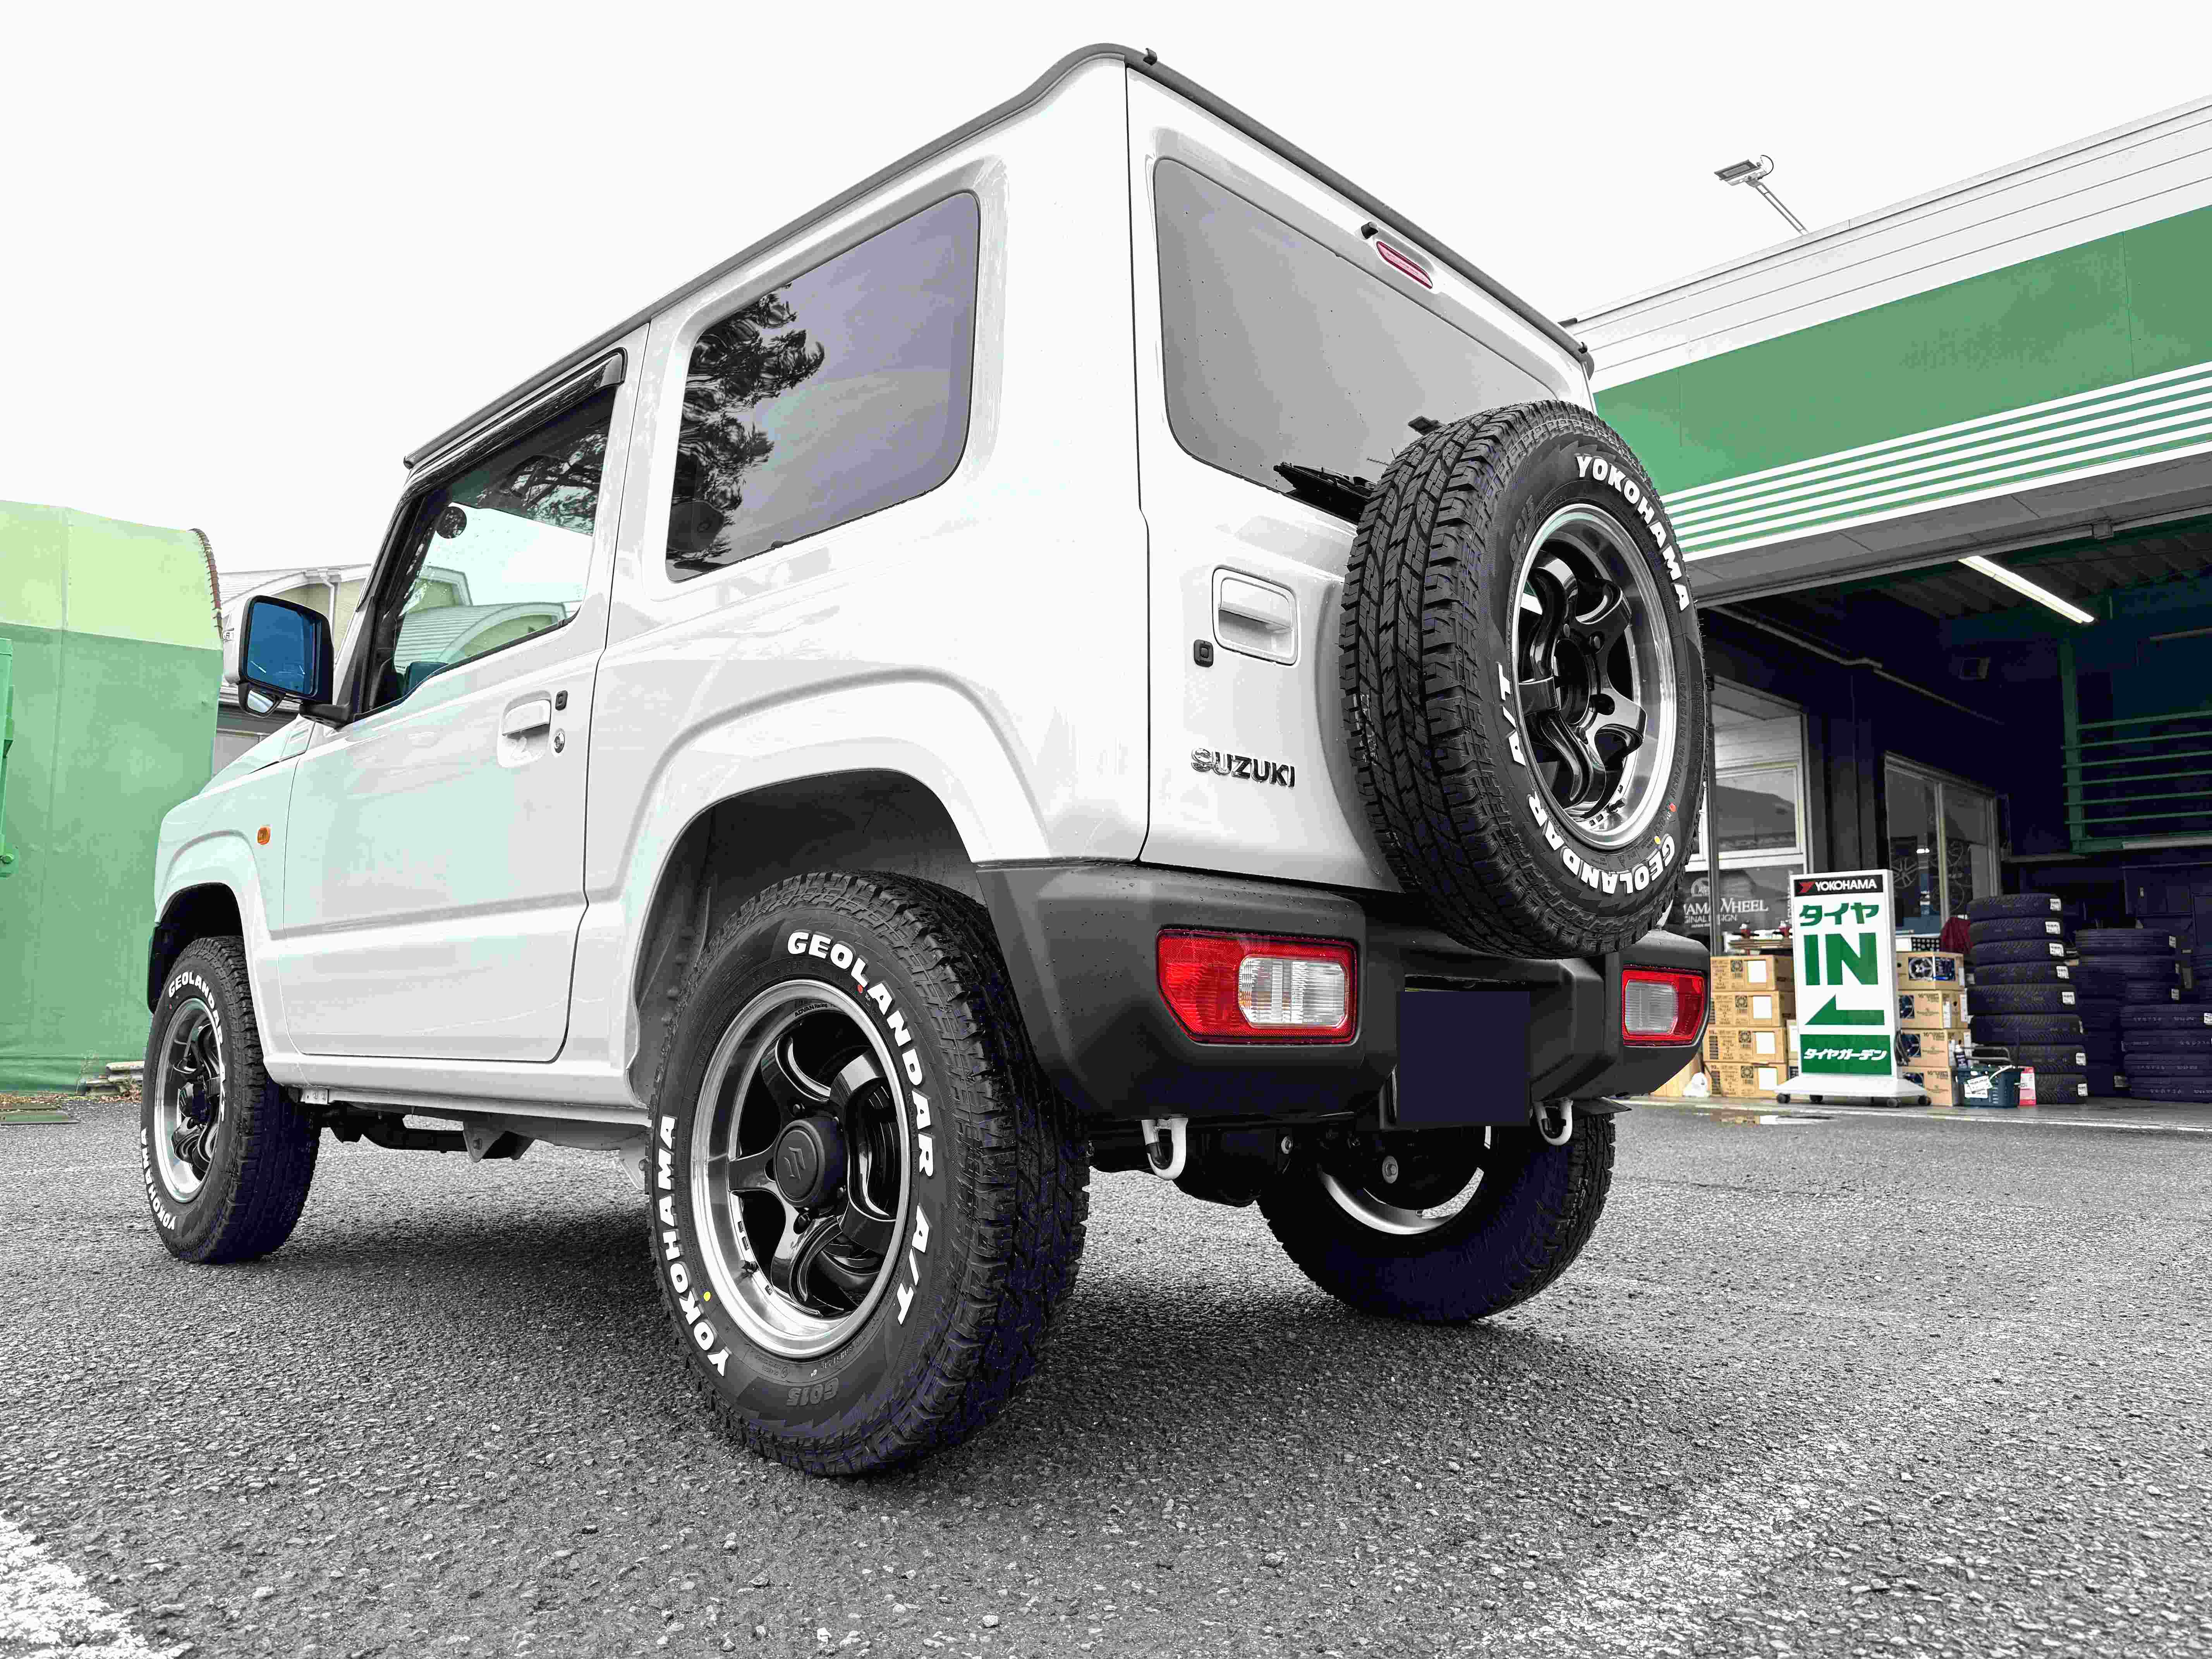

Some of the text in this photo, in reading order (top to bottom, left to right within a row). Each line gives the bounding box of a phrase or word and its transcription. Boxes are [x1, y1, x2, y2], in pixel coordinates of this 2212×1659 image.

[1576, 456, 1690, 611] YOKOHAMA
[1498, 663, 1526, 766] A/T
[1191, 747, 1295, 788] SUZUKI
[1529, 791, 1675, 894] GEOLANDAR
[1720, 897, 1769, 913] WHEEL
[1799, 902, 1879, 926] タイヤ
[1815, 879, 1877, 891] YOKOHAMA
[1803, 932, 1879, 986] IN
[168, 971, 223, 1044] GEOLANDAR
[794, 1004, 814, 1017] ADVAN
[787, 931, 933, 1177] GEOLANDAR
[1803, 1048, 1887, 1061] タイヤガーデン
[141, 1128, 177, 1230] YOKOHAMA
[658, 1116, 729, 1377] YOKOHAMA
[897, 1205, 929, 1324] A/T
[786, 1376, 839, 1407] G015
